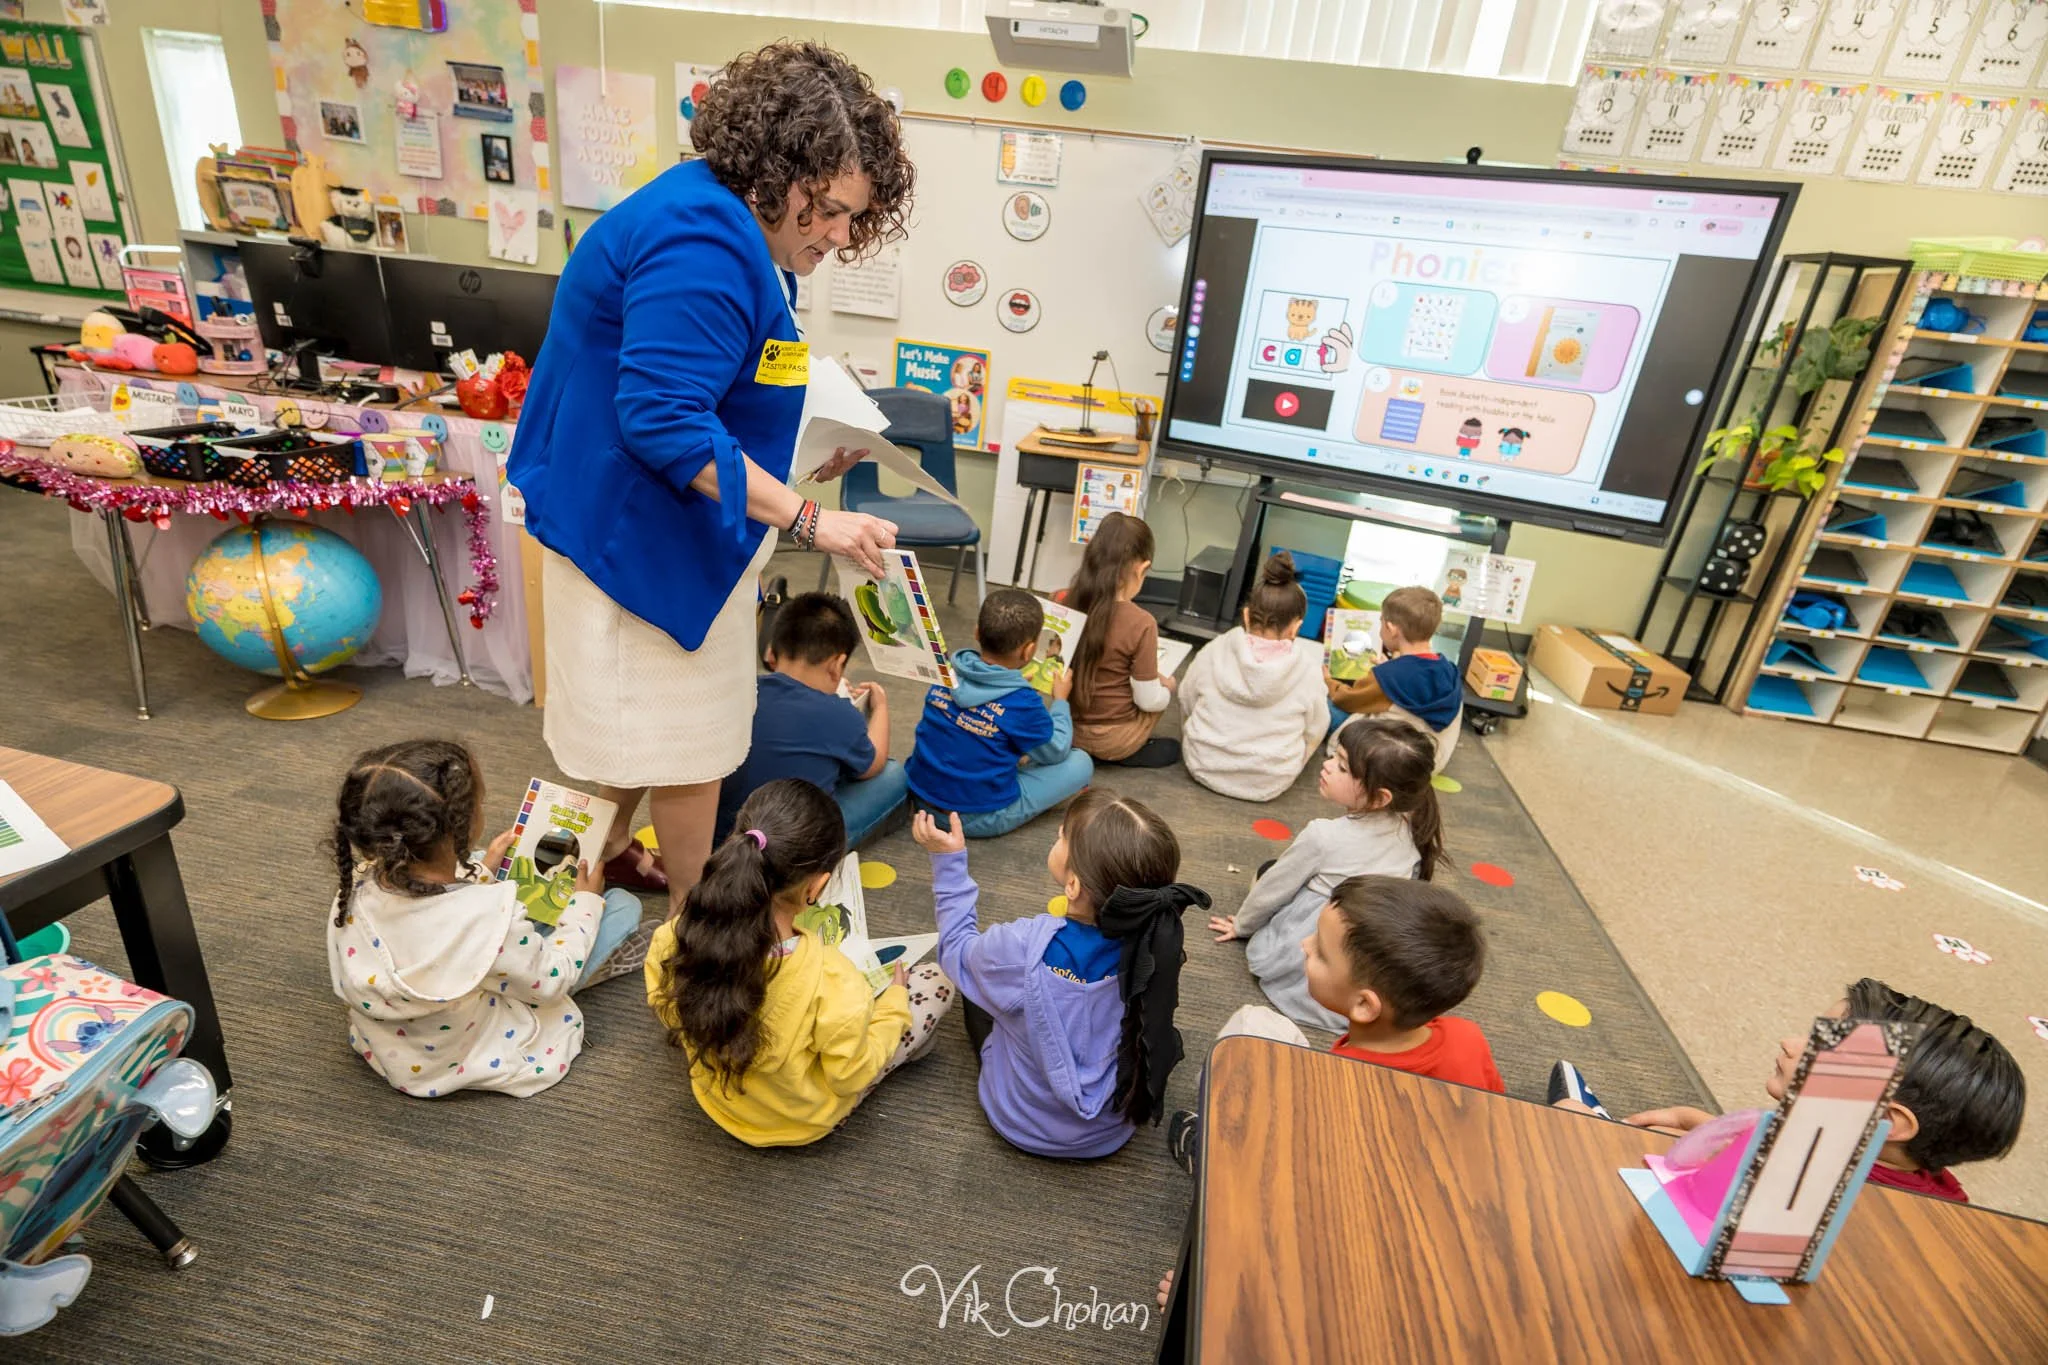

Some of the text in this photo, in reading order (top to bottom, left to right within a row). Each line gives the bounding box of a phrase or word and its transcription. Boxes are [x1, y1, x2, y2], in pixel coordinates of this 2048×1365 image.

[1854, 12, 1864, 28] 4
[1929, 17, 1939, 34] 5
[1039, 26, 1069, 36] HITACHI
[2007, 24, 2018, 41] 6
[988, 76, 1000, 98] 4
[1597, 98, 1614, 114] 10
[1669, 105, 1679, 118] 11
[581, 104, 632, 126] MAKE
[1739, 109, 1756, 125] 12
[1810, 115, 1828, 132] 13
[578, 125, 635, 147] TODAY
[1884, 123, 1901, 138] 14
[1960, 129, 1977, 146] 15
[578, 145, 638, 169] A GOOD
[591, 168, 625, 187] DAY
[900, 346, 949, 365] Let's Make
[762, 360, 808, 372] VISITOR PASS
[905, 361, 942, 382] Music
[131, 390, 175, 406] MUSTARD
[228, 404, 255, 418] MAYO
[1495, 559, 1515, 573] Rug
[549, 815, 587, 834] Feelings
[577, 812, 593, 827] Big
